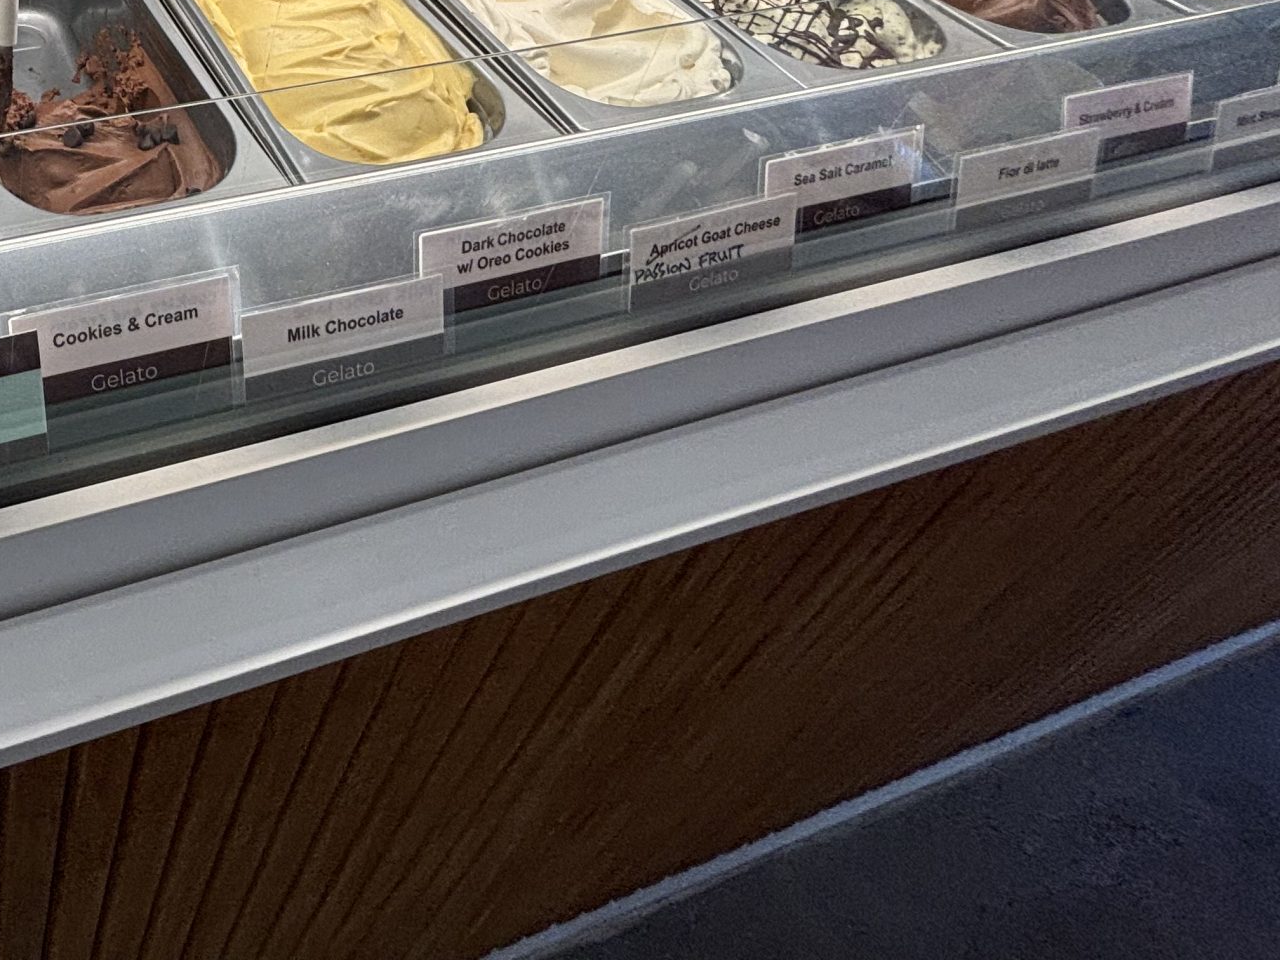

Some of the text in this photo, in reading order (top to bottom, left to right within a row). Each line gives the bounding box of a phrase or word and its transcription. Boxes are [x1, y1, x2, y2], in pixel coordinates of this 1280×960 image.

[794, 155, 892, 186] Sea Salt Caramel
[813, 205, 860, 225] Gelato
[461, 221, 566, 254] Dark Chocolate
[649, 216, 781, 257] Apricot Goat Cheese
[457, 240, 570, 274] w/ Oreo Cookies
[634, 244, 744, 284] PASSION FRUIT
[487, 279, 542, 300] Gelato
[688, 270, 739, 291] Gelato
[52, 307, 198, 348] Cookies & Cream
[287, 308, 404, 342] Milk Chocolate
[91, 366, 159, 391] Gelato
[312, 361, 375, 386] Gelato
